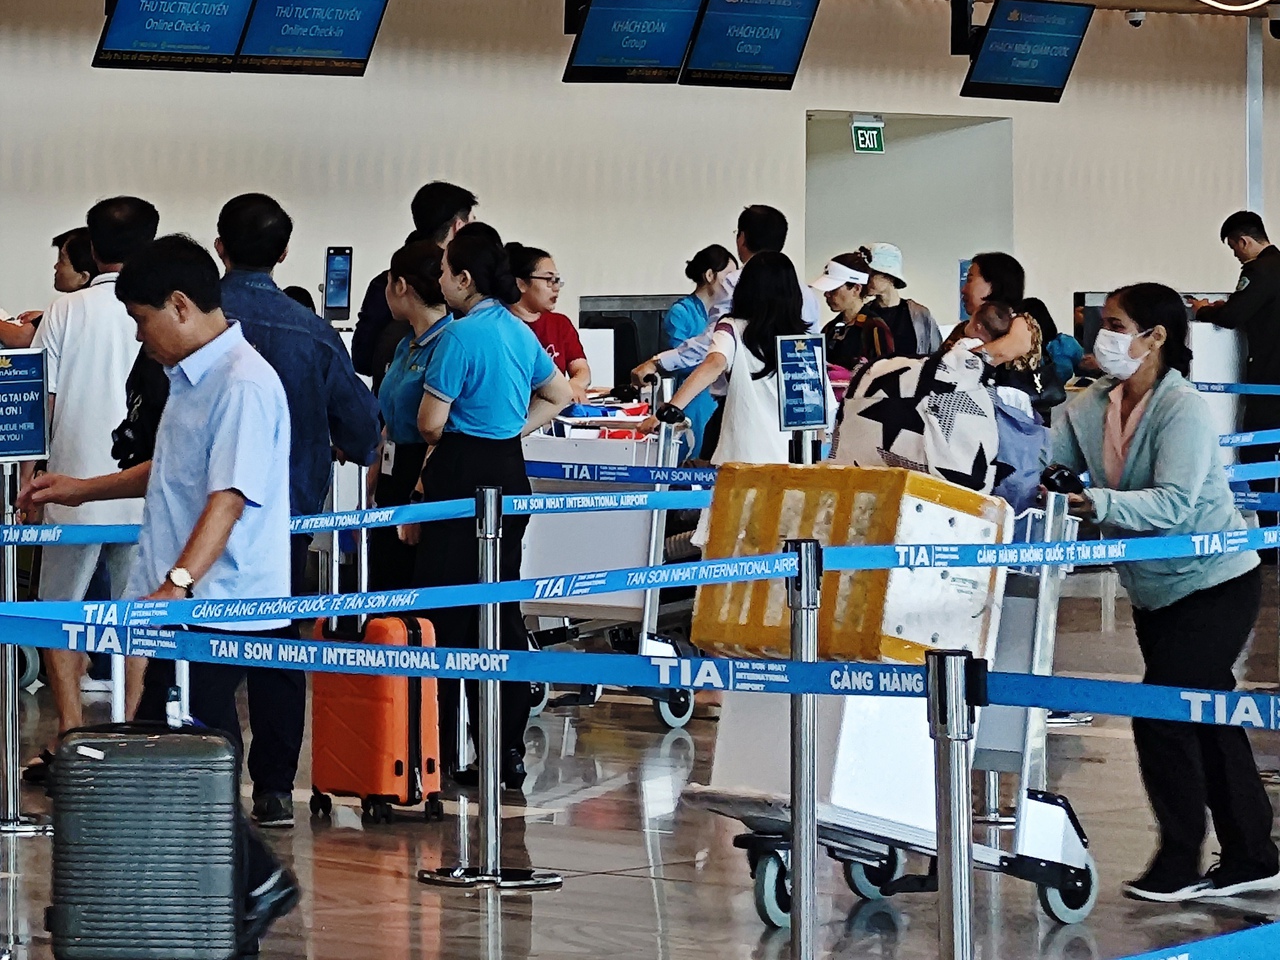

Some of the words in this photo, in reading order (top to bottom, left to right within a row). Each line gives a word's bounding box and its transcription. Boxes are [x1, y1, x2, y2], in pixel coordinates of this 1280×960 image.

[145, 18, 173, 31] Online
[174, 19, 211, 32] Check-in
[281, 24, 308, 36] Online
[309, 25, 344, 37] Check-in
[622, 36, 647, 50] Group
[737, 41, 761, 56] Group
[858, 130, 877, 148] EXIT
[19, 422, 35, 430] HERE
[7, 433, 20, 442] YOU
[562, 465, 591, 480] TIA
[650, 470, 669, 480] TAN
[670, 471, 692, 481] SON
[513, 499, 528, 511] TAN
[529, 498, 544, 510] SON
[546, 497, 564, 509] NHAT
[566, 496, 618, 509] INTERNATIONAL
[620, 495, 648, 506] AIRPORT
[301, 514, 360, 529] INTERNATIONAL
[362, 510, 394, 523] AIRPORT
[1191, 533, 1223, 555] TIA
[895, 546, 930, 566] TIA
[626, 572, 645, 586] TAN
[647, 570, 670, 584] SON
[671, 567, 698, 582] NHAT
[698, 561, 771, 579] INTERNATIONAL
[534, 578, 563, 599] TIA
[83, 603, 118, 625] TIA
[224, 600, 256, 616] HÀNG
[256, 598, 297, 615] KHÔNG
[62, 623, 123, 653] TIA
[209, 639, 238, 658] TAN
[244, 642, 272, 660] SON
[278, 645, 317, 664] NHAT
[322, 647, 439, 670] INTERNATIONAL
[445, 652, 509, 672] AIRPORT
[651, 658, 724, 688] TIA
[830, 665, 873, 691] CẢNG
[879, 668, 924, 692] HÀNG
[1180, 691, 1265, 728] TIA
